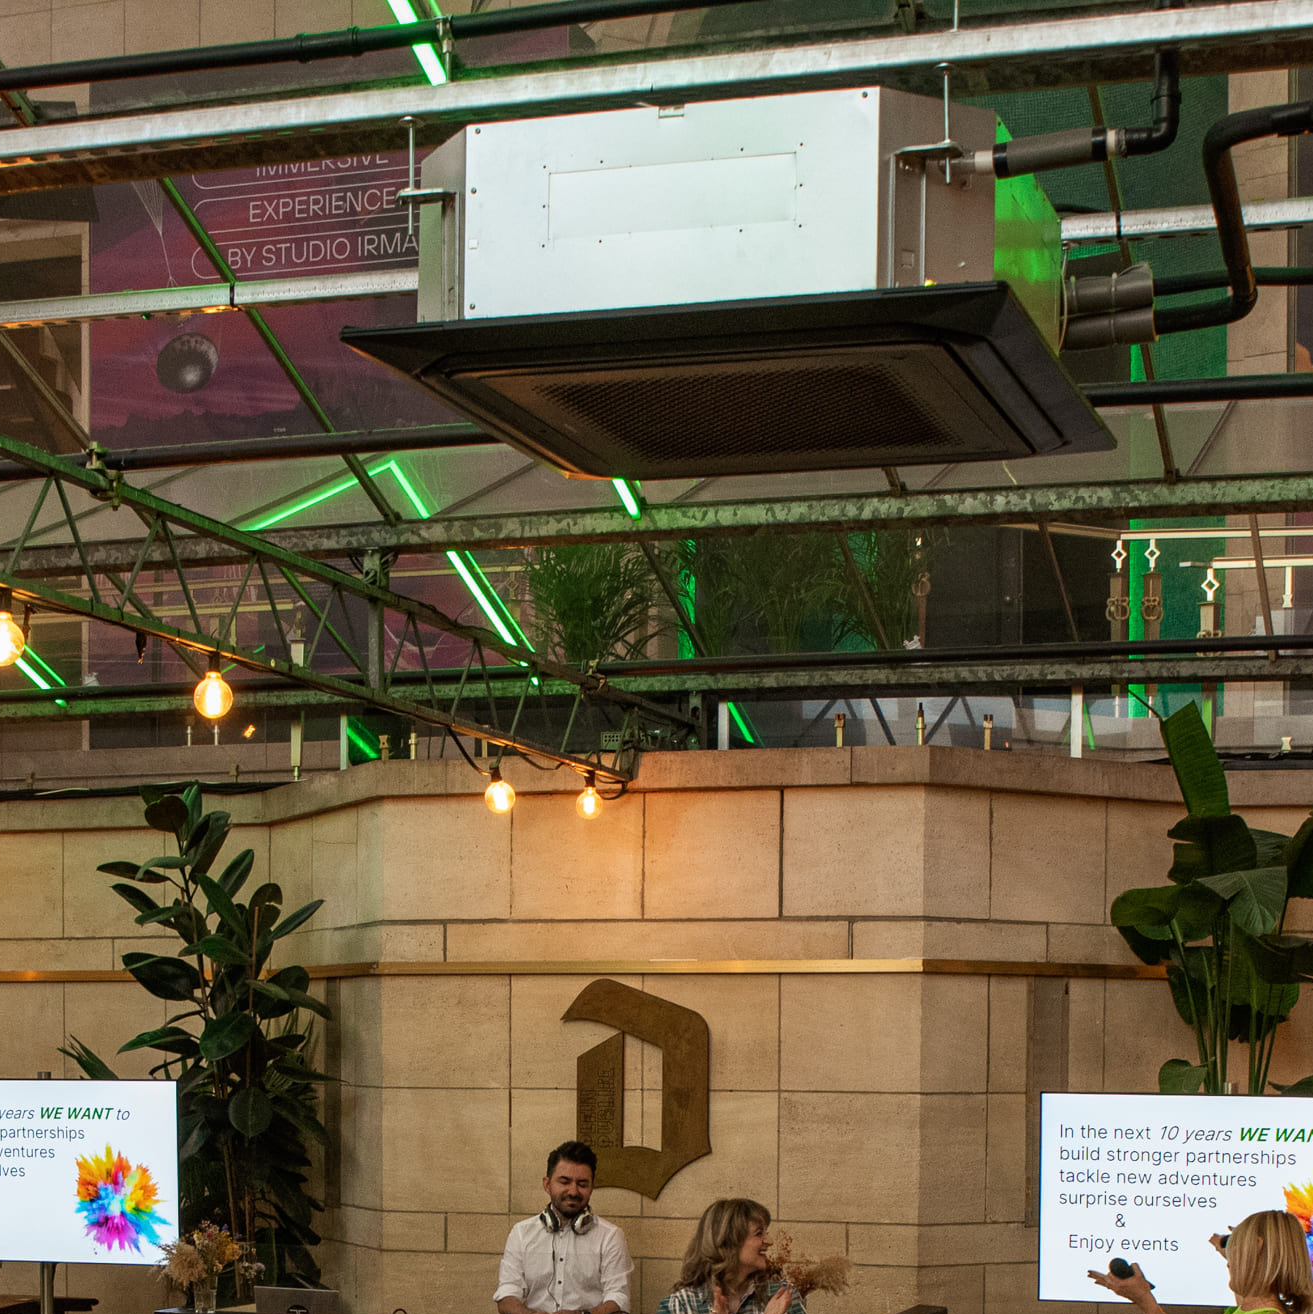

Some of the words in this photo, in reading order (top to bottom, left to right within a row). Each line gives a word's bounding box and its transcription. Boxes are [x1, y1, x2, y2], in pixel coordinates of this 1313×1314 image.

[249, 187, 396, 223] EXPERIENCE
[228, 247, 256, 270] BY
[262, 238, 350, 266] STUDIO
[358, 233, 418, 256] IRMA
[40, 1107, 65, 1119] WE
[67, 1107, 115, 1120] WANT
[116, 1109, 131, 1120] to
[0, 1126, 85, 1142] partnerships
[1060, 1124, 1075, 1138] In
[1079, 1125, 1108, 1139] the
[1113, 1127, 1152, 1140] next
[1160, 1126, 1180, 1140] 10
[1182, 1130, 1233, 1144] years
[1239, 1127, 1272, 1142] WE
[1059, 1146, 1101, 1160] build
[1106, 1148, 1181, 1166] stronger
[1185, 1150, 1297, 1168] partnerships
[1058, 1169, 1111, 1183] tackle
[1116, 1173, 1153, 1184] new
[1158, 1171, 1257, 1187] adventures
[1059, 1191, 1128, 1208] surprise
[1133, 1193, 1217, 1208] ourselves
[1114, 1214, 1127, 1227] &
[1068, 1234, 1115, 1253] Enjoy
[1120, 1238, 1179, 1251] events
